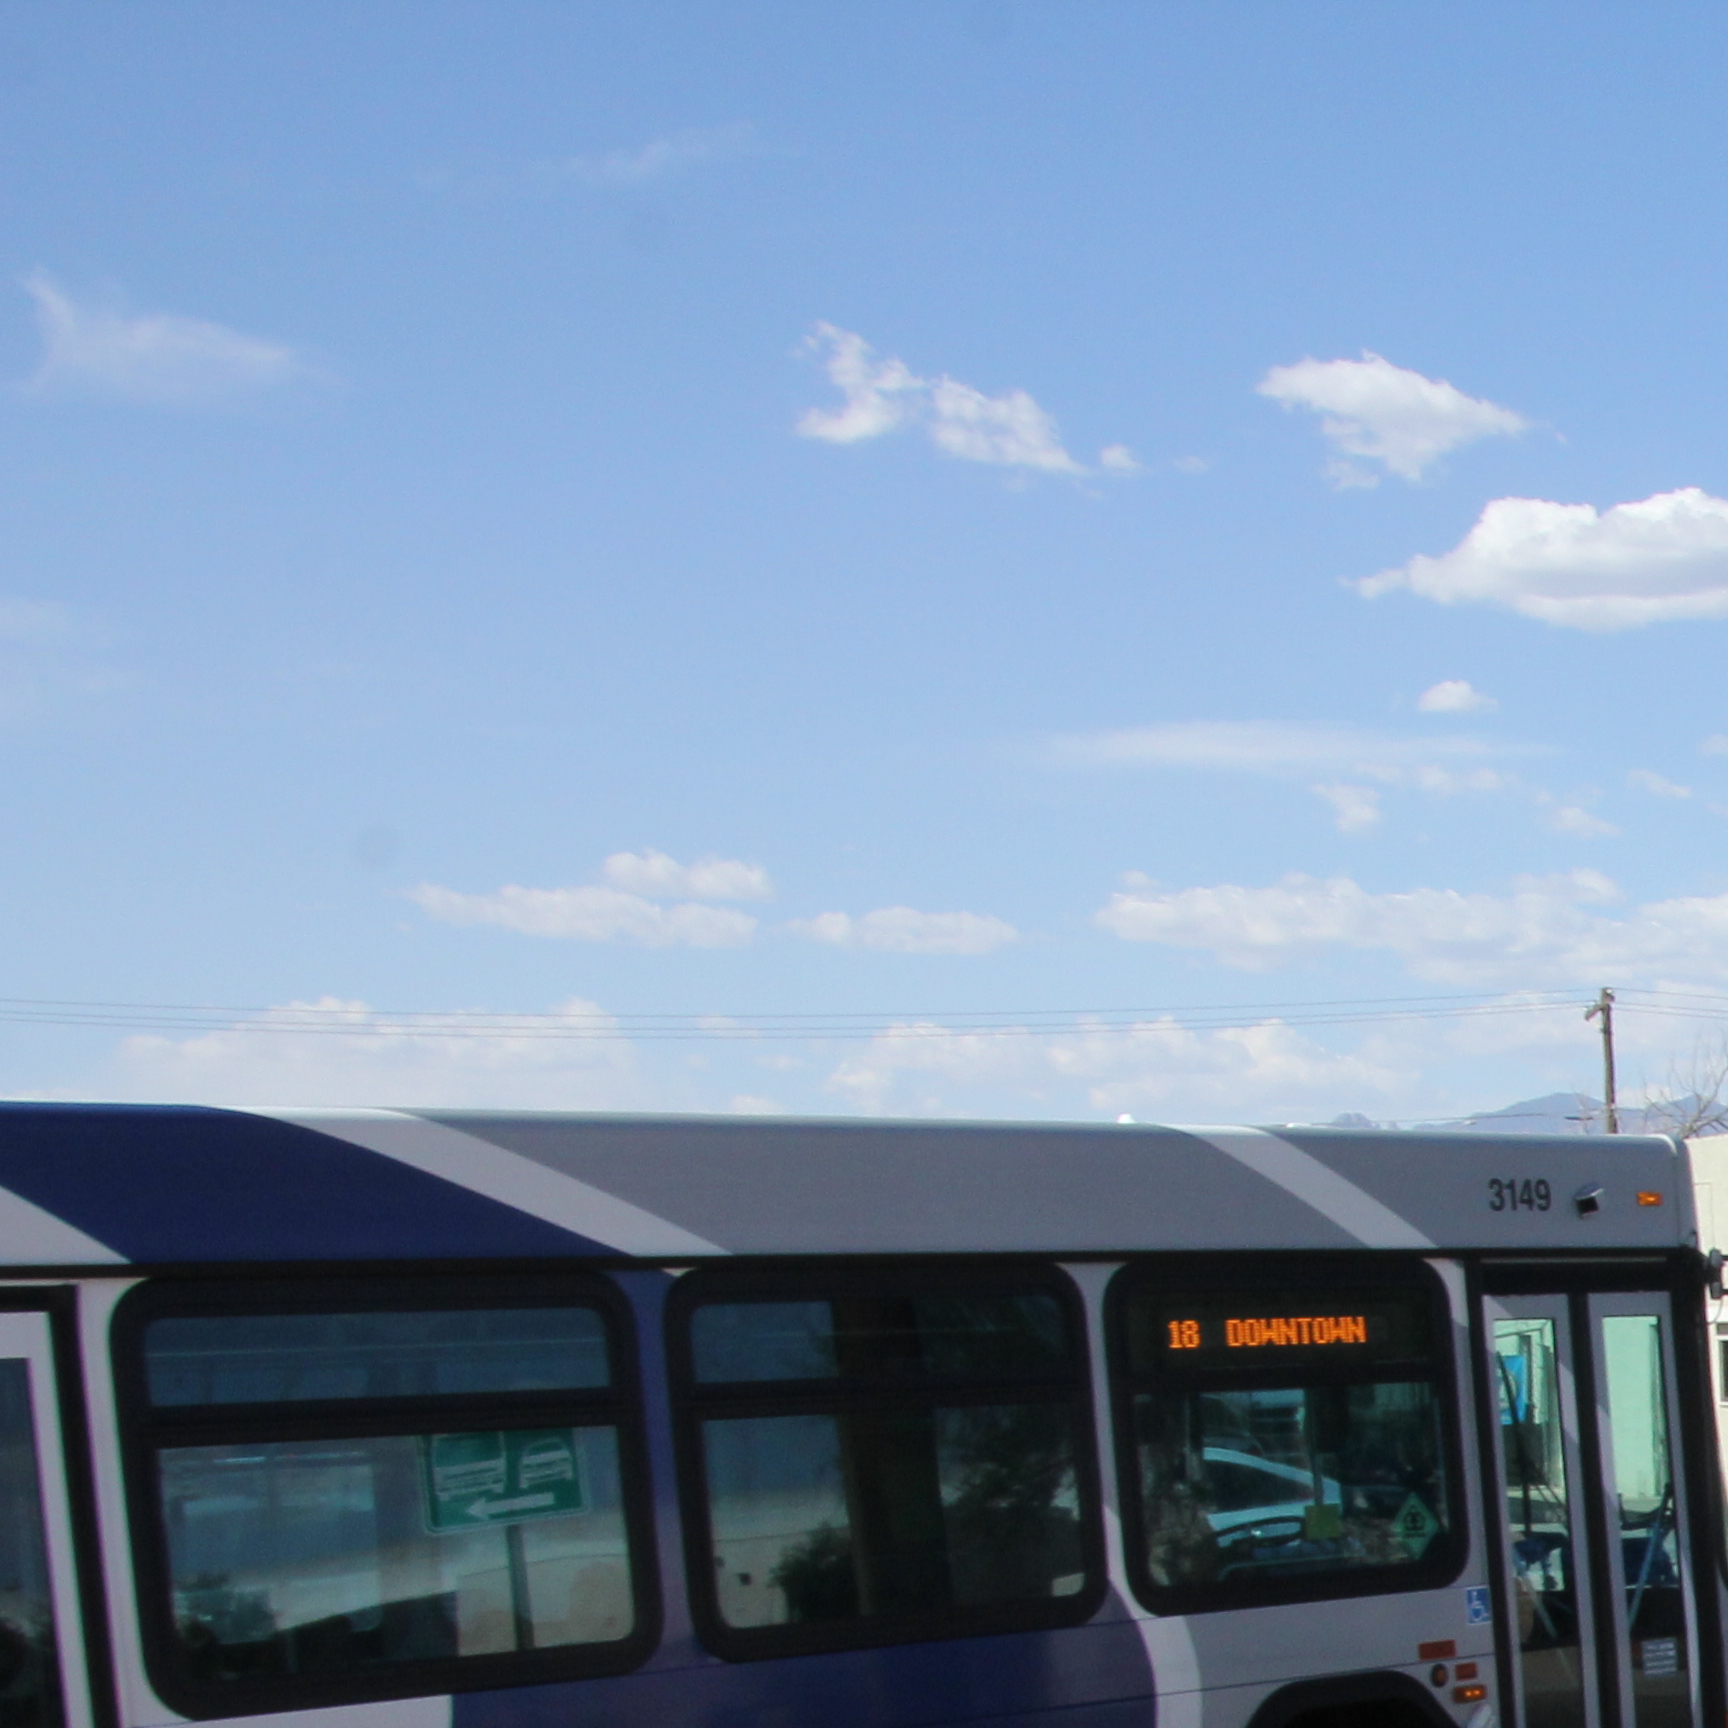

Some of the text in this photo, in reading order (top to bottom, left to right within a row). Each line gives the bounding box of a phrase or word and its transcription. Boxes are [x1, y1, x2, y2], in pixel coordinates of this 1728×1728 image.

[1487, 1178, 1552, 1213] 3149
[1167, 1316, 1367, 1349] 18 DOWNTOWN
